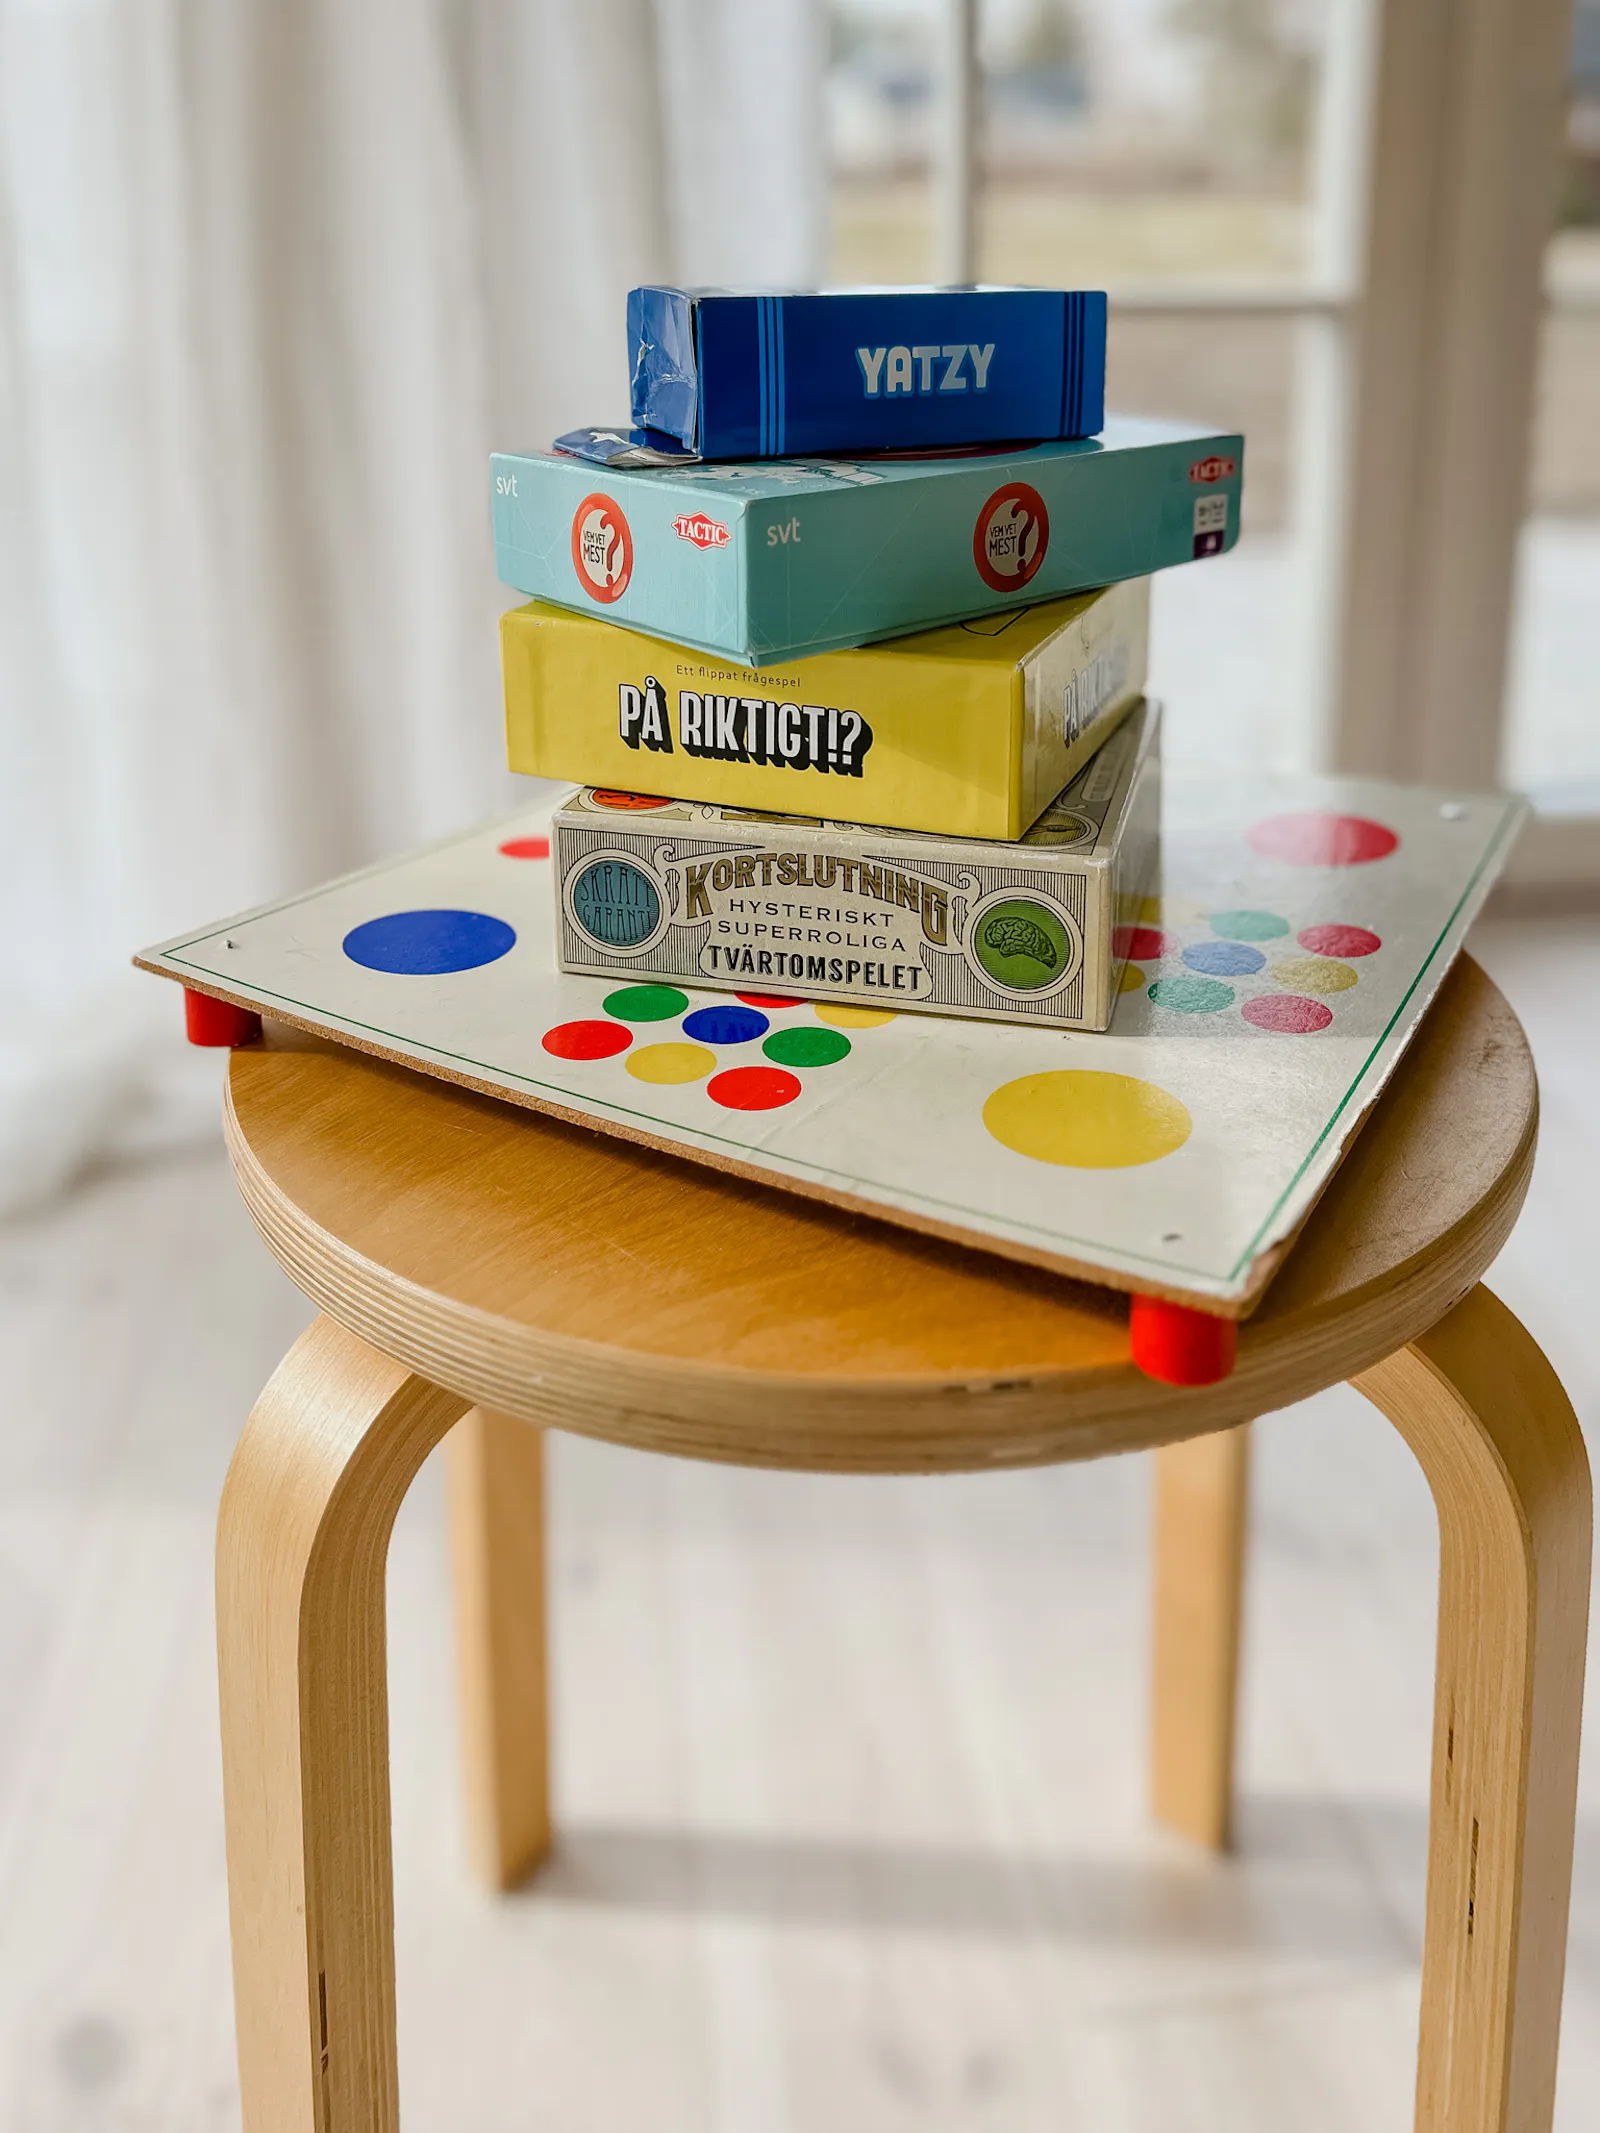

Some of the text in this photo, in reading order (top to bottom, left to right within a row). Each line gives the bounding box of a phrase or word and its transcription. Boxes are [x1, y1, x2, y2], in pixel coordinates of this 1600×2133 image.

[856, 343, 995, 398] YATZY
[496, 474, 517, 498] svt
[583, 530, 606, 546] VEM VET
[678, 518, 725, 545] TACTIC
[767, 517, 801, 546] svt
[989, 523, 1017, 538] VEM VET
[583, 544, 606, 565] MEST
[989, 536, 1017, 557] MEST
[676, 665, 801, 688] Ett flippat frågespel
[619, 676, 873, 777] PÅ RIKTIGT!?
[580, 865, 651, 907] SKRATT
[686, 853, 949, 946] KORTSLUTNING
[582, 905, 652, 941] GARANTI
[730, 898, 894, 928] HYSTERISKT
[717, 919, 906, 952] SUPERROLIGA
[707, 944, 923, 991] TVÄRTOMSPELET
